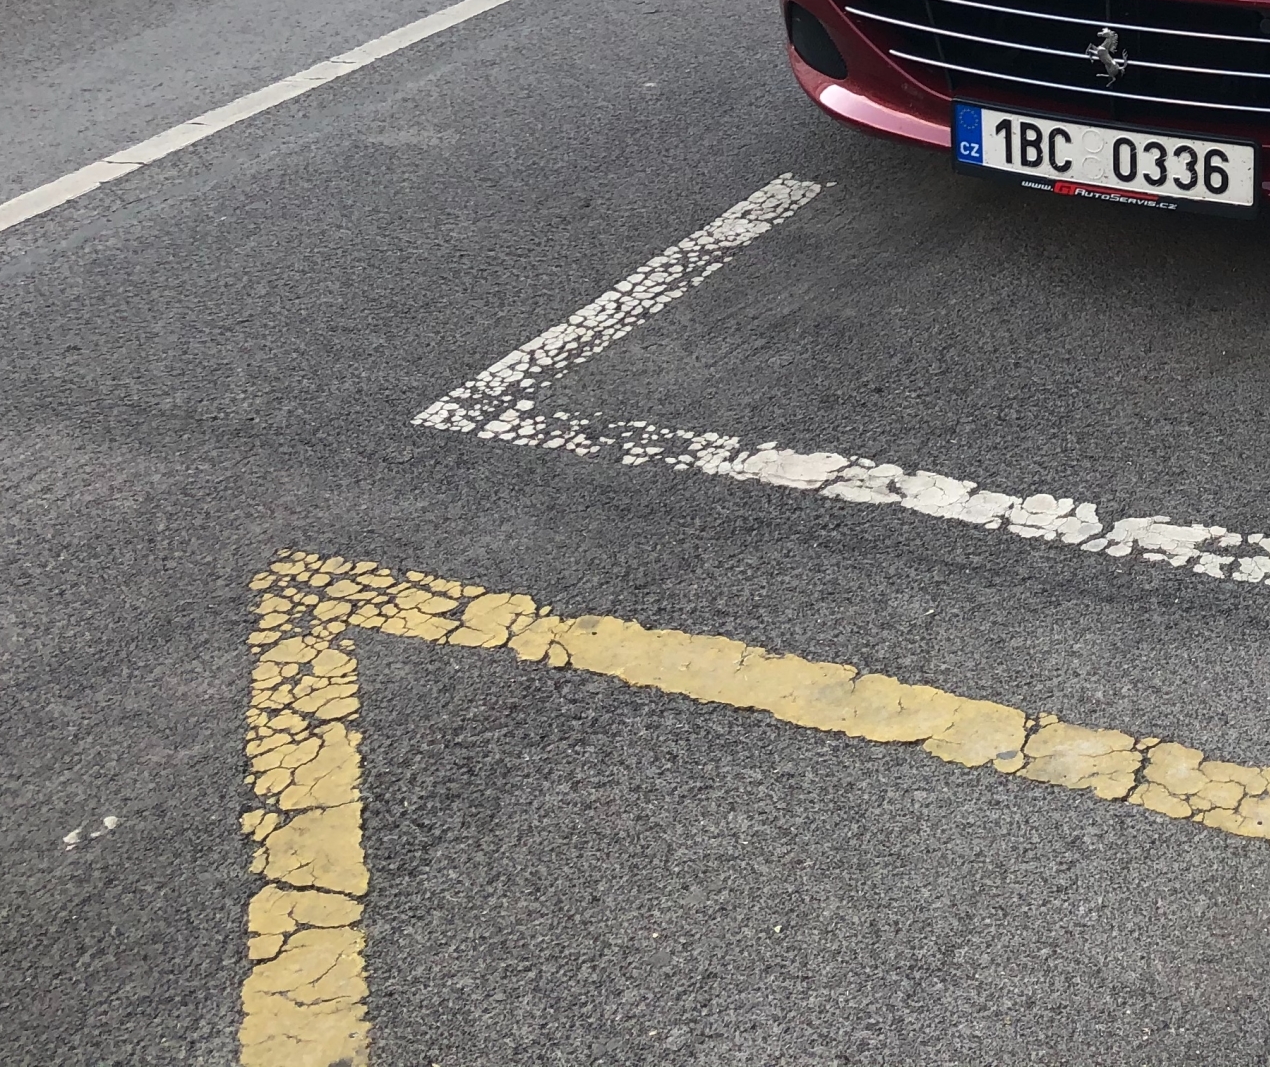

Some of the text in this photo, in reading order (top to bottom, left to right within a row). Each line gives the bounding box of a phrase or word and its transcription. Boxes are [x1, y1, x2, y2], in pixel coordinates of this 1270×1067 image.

[960, 141, 980, 158] CZ
[995, 119, 1229, 195] 1BC 0336
